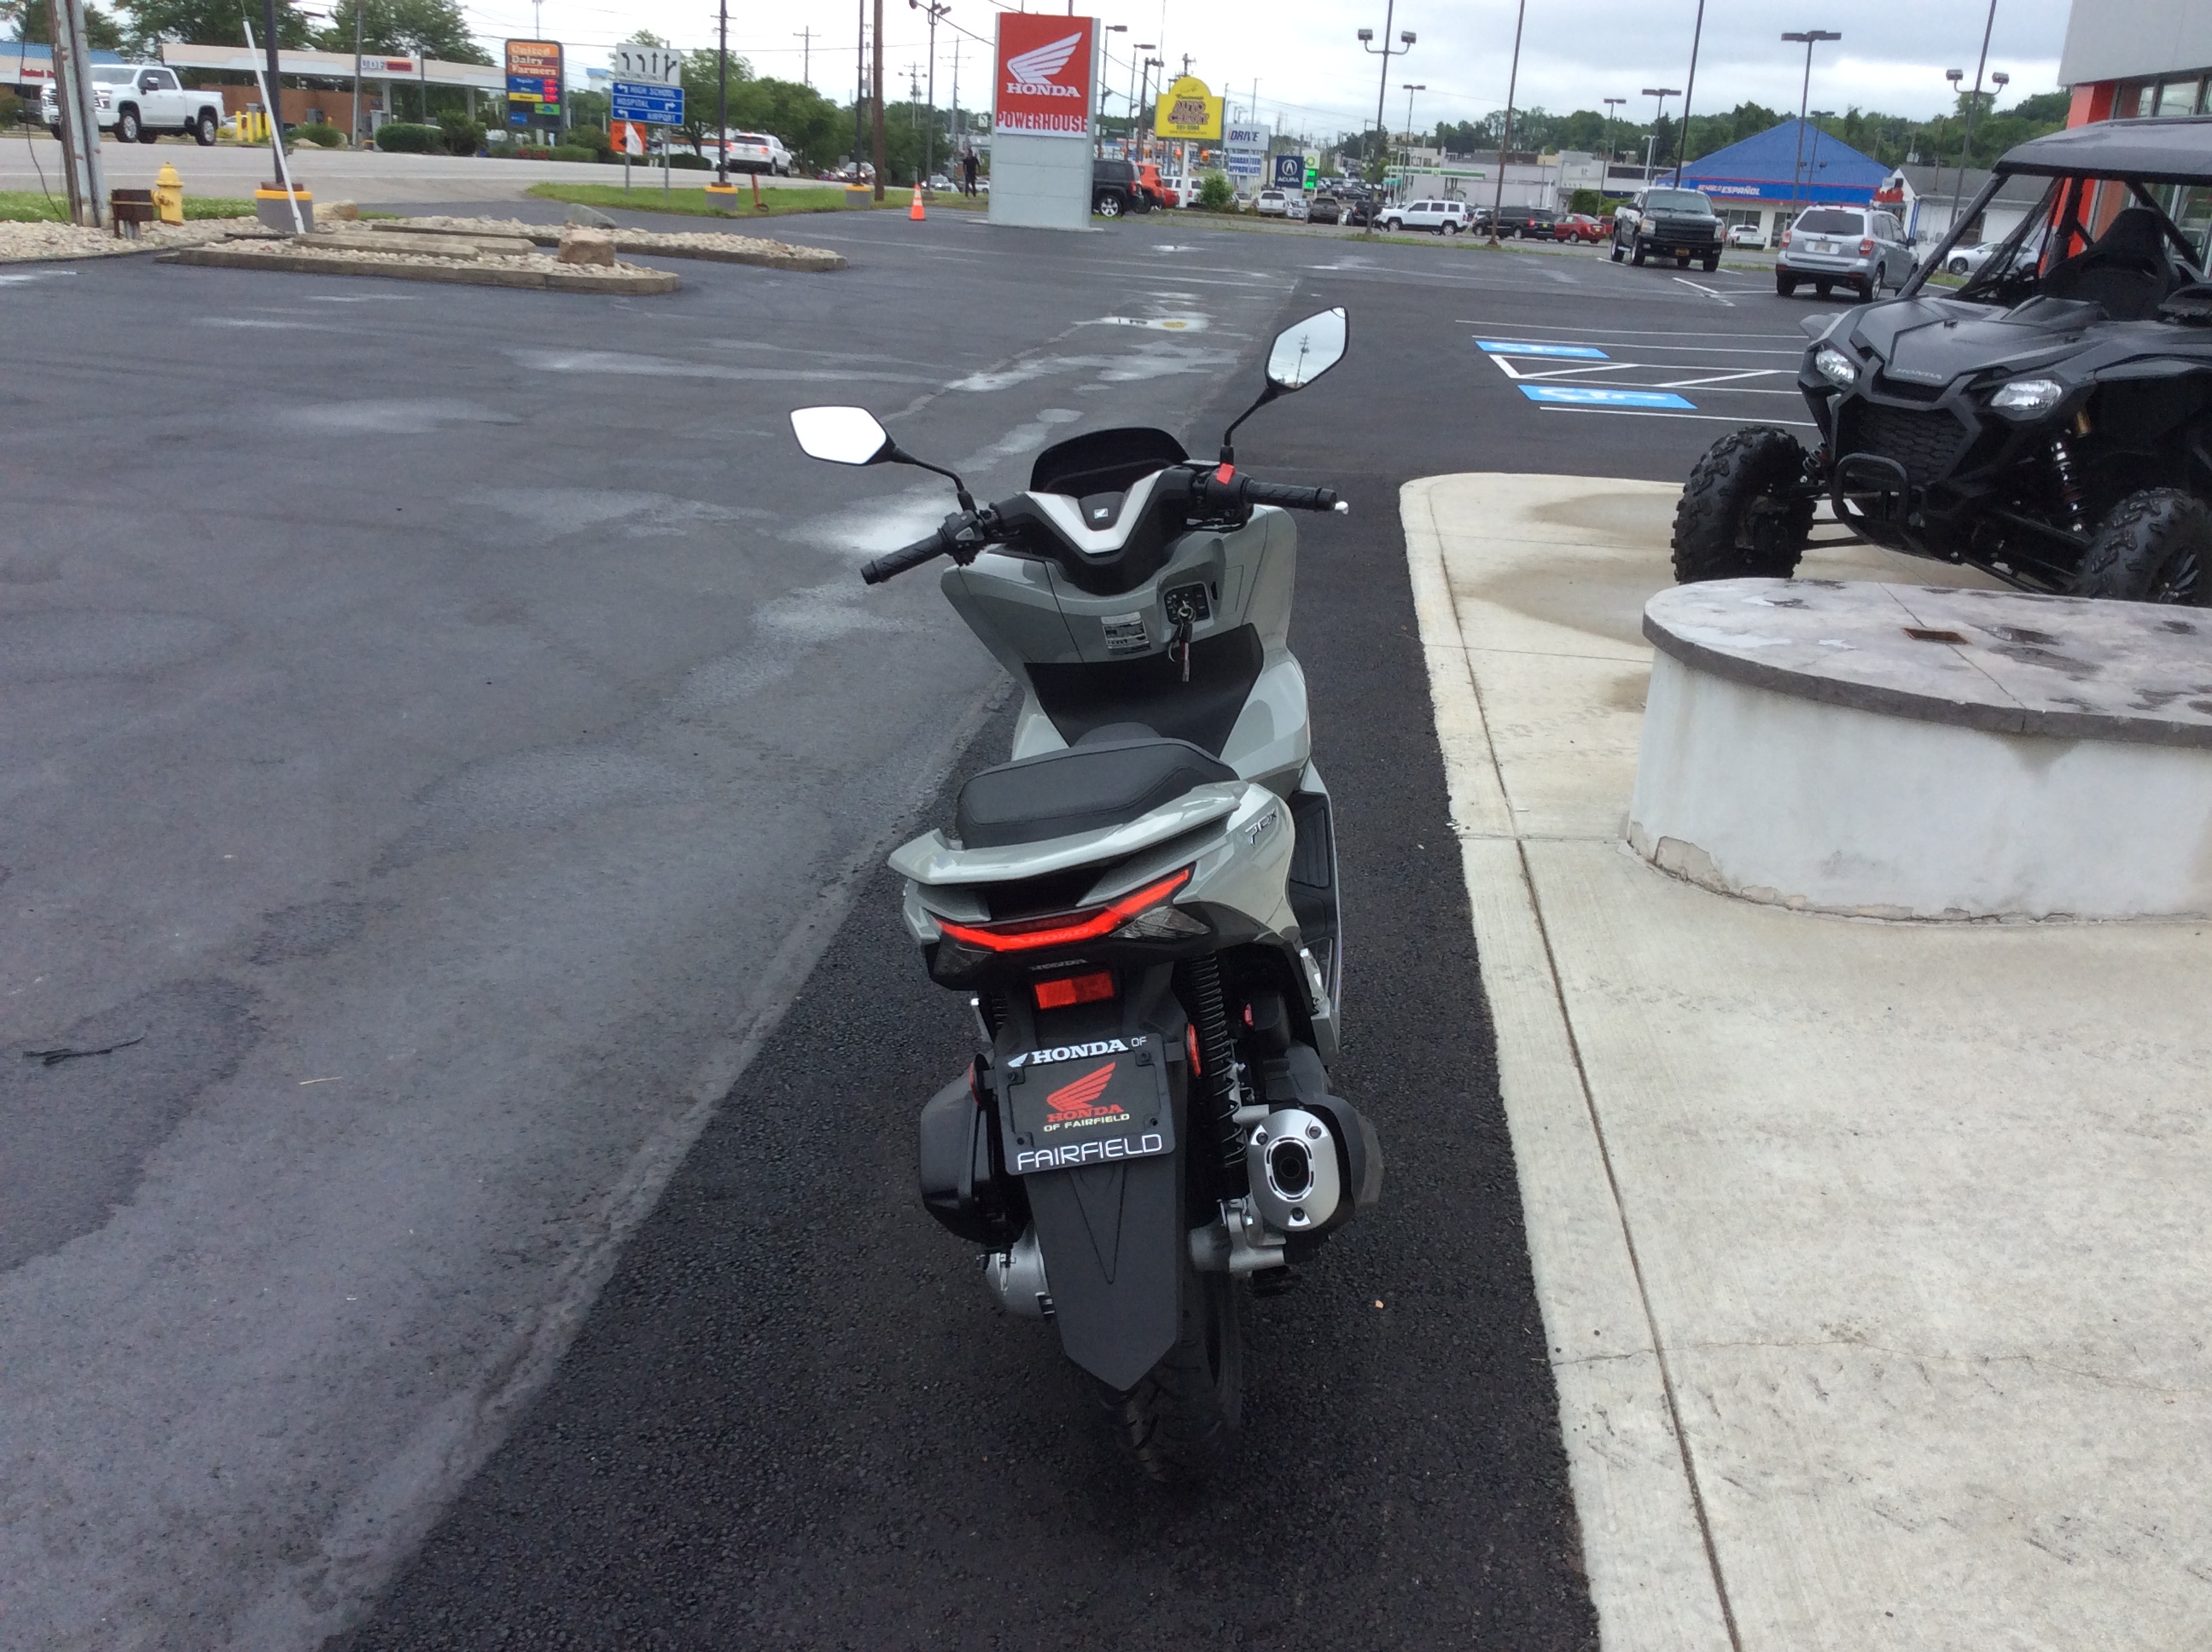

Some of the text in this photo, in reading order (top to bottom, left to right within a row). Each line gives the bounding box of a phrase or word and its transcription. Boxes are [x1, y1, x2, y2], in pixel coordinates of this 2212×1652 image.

[510, 44, 550, 56] United
[511, 55, 544, 66] Dairy
[512, 65, 556, 75] Farmers
[630, 86, 676, 97] HIGH SCHOOL
[1006, 82, 1081, 97] HONDA
[617, 97, 649, 108] HOSPITAL
[1173, 101, 1207, 113] AUTO
[647, 113, 676, 123] AIRPORT
[995, 111, 1087, 133] POWERHOUSE
[1721, 185, 1761, 195] ESPAÑOL
[1245, 808, 1277, 848] PCX
[1028, 958, 1088, 971] HONDA
[1031, 1036, 1147, 1065] HONDA OF
[1047, 1104, 1124, 1122] HONDA
[1044, 1114, 1130, 1132] OF FAIRFIELD
[1016, 1133, 1162, 1171] FAIRFIELD
